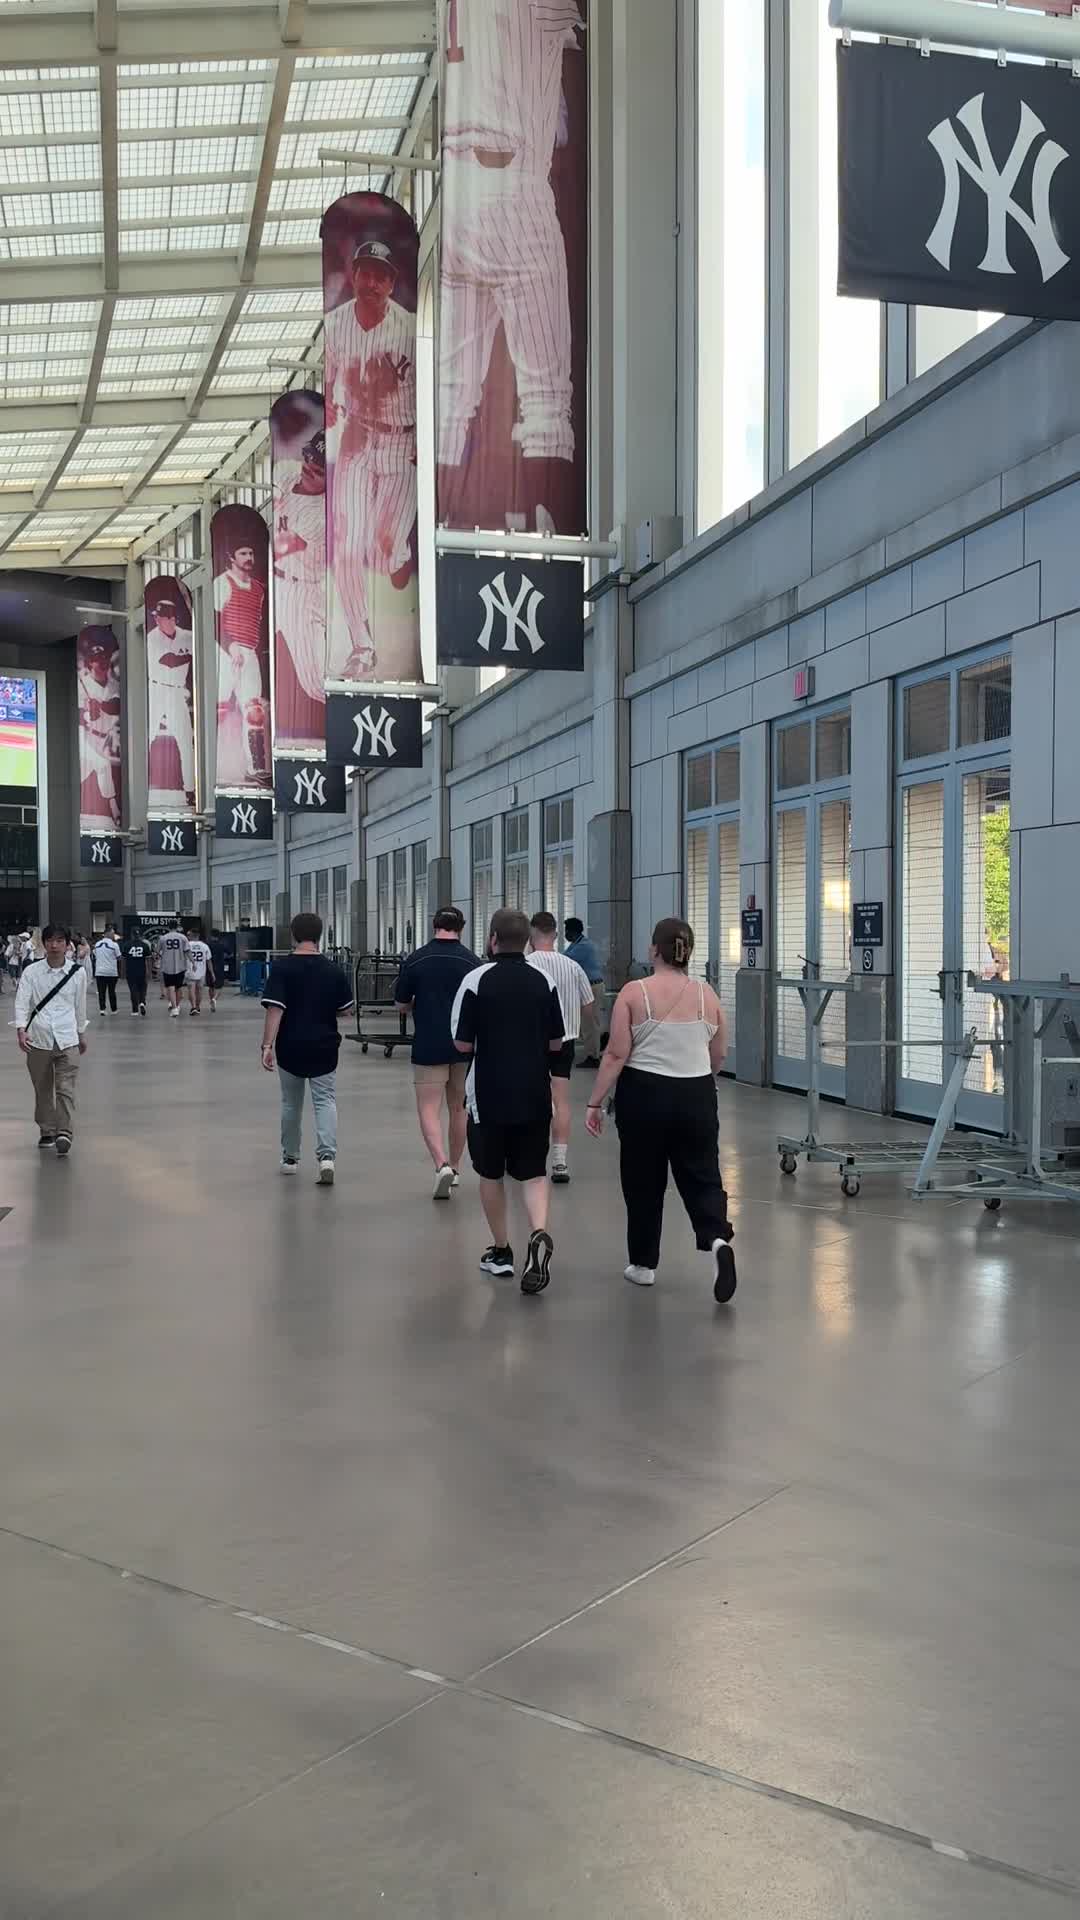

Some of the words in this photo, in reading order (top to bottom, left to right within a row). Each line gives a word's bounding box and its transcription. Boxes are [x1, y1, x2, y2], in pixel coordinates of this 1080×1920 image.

[926, 92, 1071, 283] NY
[477, 571, 545, 654] NY
[352, 705, 397, 758] NY
[293, 767, 327, 806] NY
[231, 803, 258, 833] NY
[91, 841, 111, 863] NY
[161, 825, 184, 851] NY
[141, 917, 159, 925] TEAM
[160, 917, 182, 925] STE
[129, 946, 144, 957] 42
[166, 939, 180, 949] 99
